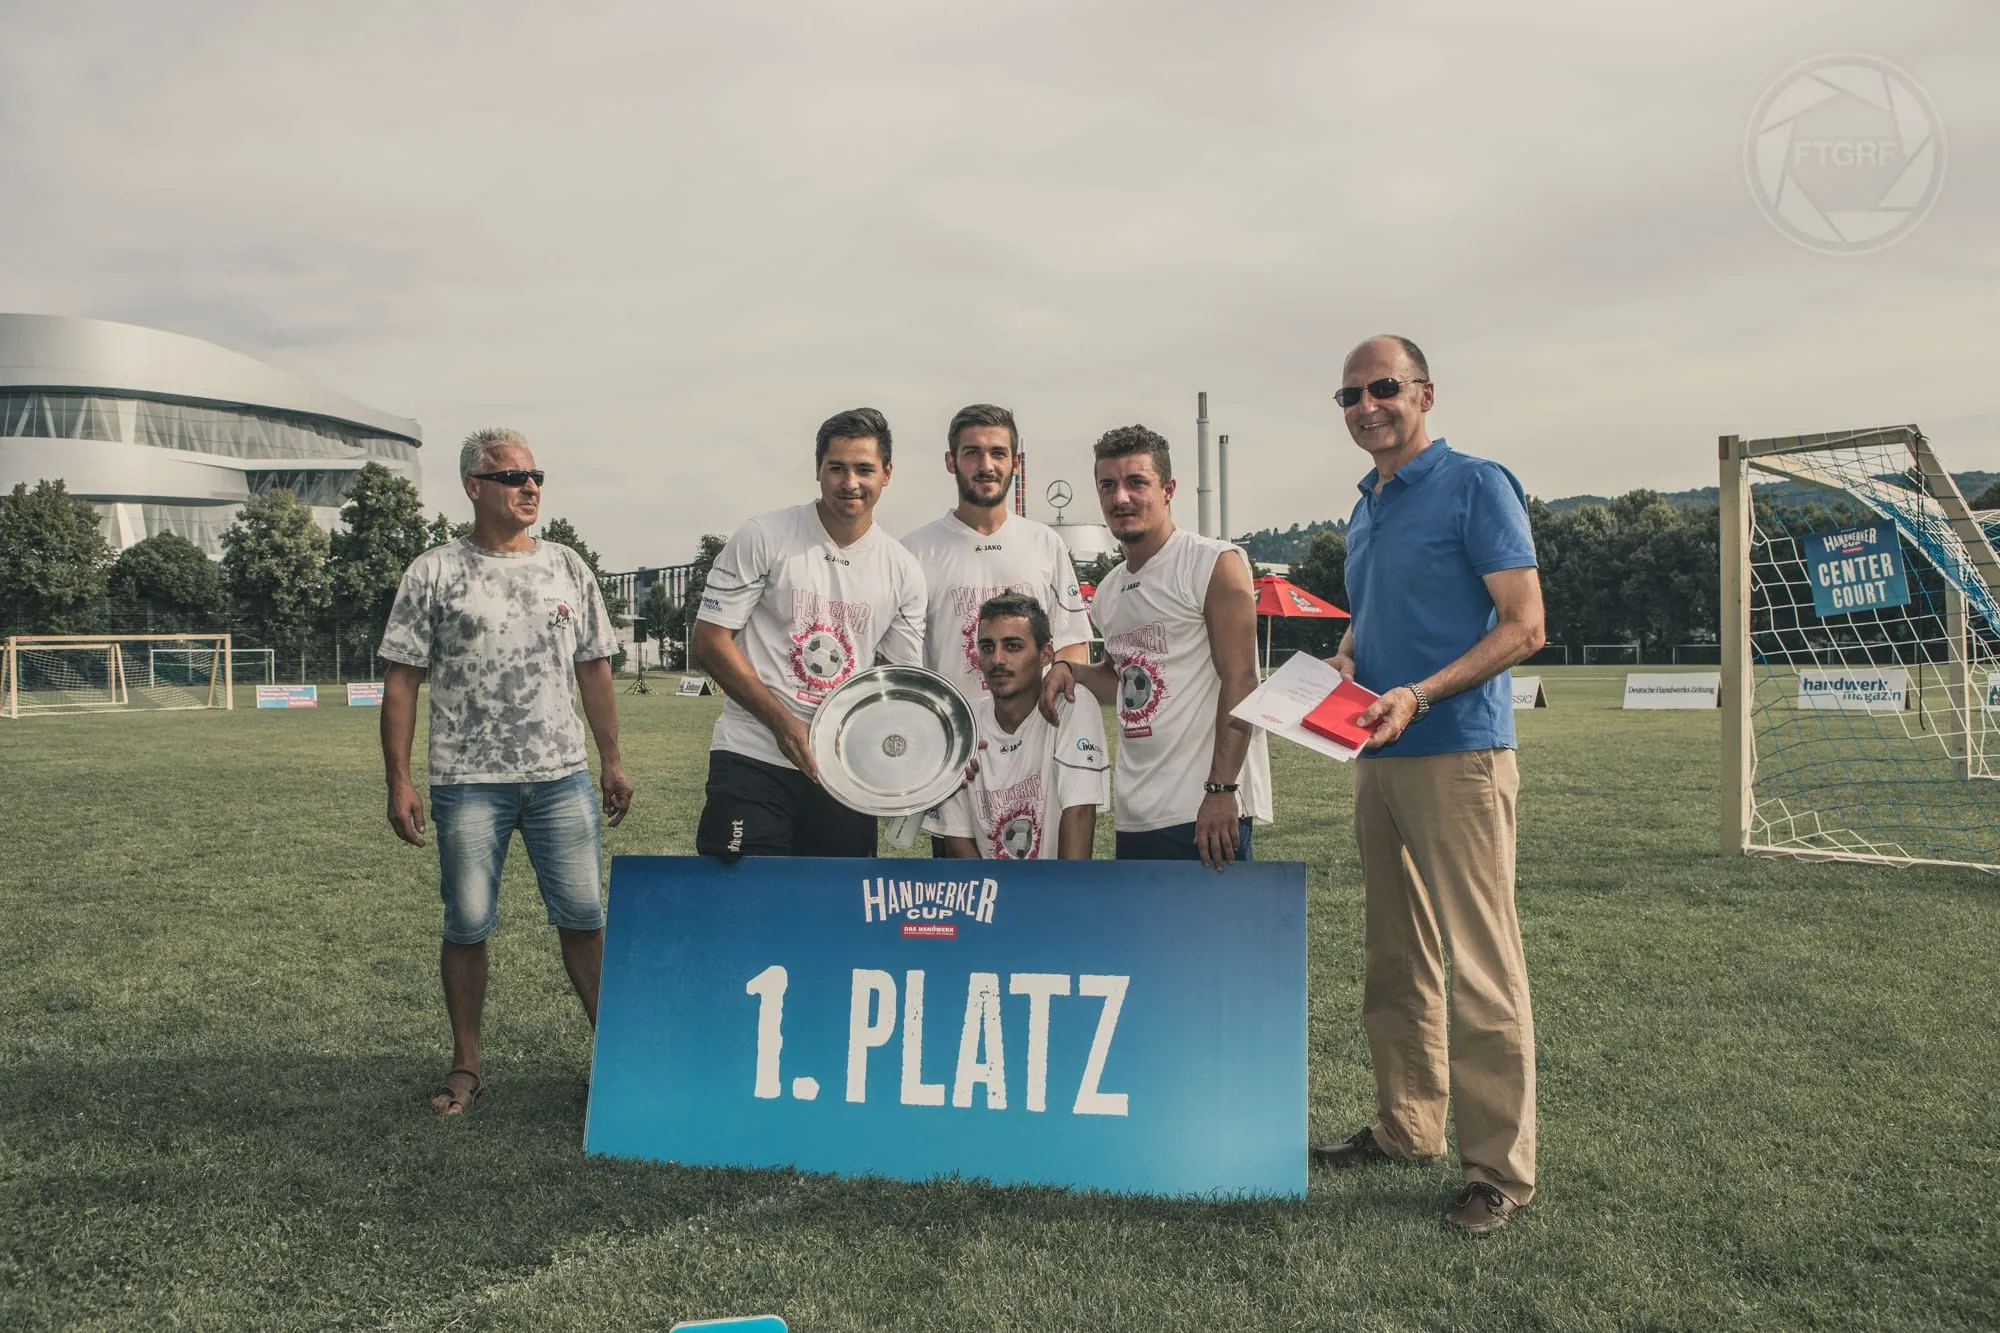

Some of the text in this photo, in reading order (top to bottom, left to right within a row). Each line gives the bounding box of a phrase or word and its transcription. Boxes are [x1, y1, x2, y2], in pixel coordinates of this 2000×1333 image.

[1823, 527, 1876, 553] HANDWERKER
[1818, 552, 1895, 588] CENTER
[1832, 580, 1887, 604] COURT
[1628, 685, 1655, 694] Deutsche
[1803, 677, 1889, 691] handwerk
[1511, 692, 1533, 704] ssic
[1842, 689, 1901, 704] magazin
[862, 877, 999, 924] HANDWERKER
[906, 907, 953, 920] CUP
[746, 965, 1130, 1117] 1. PLATZ
